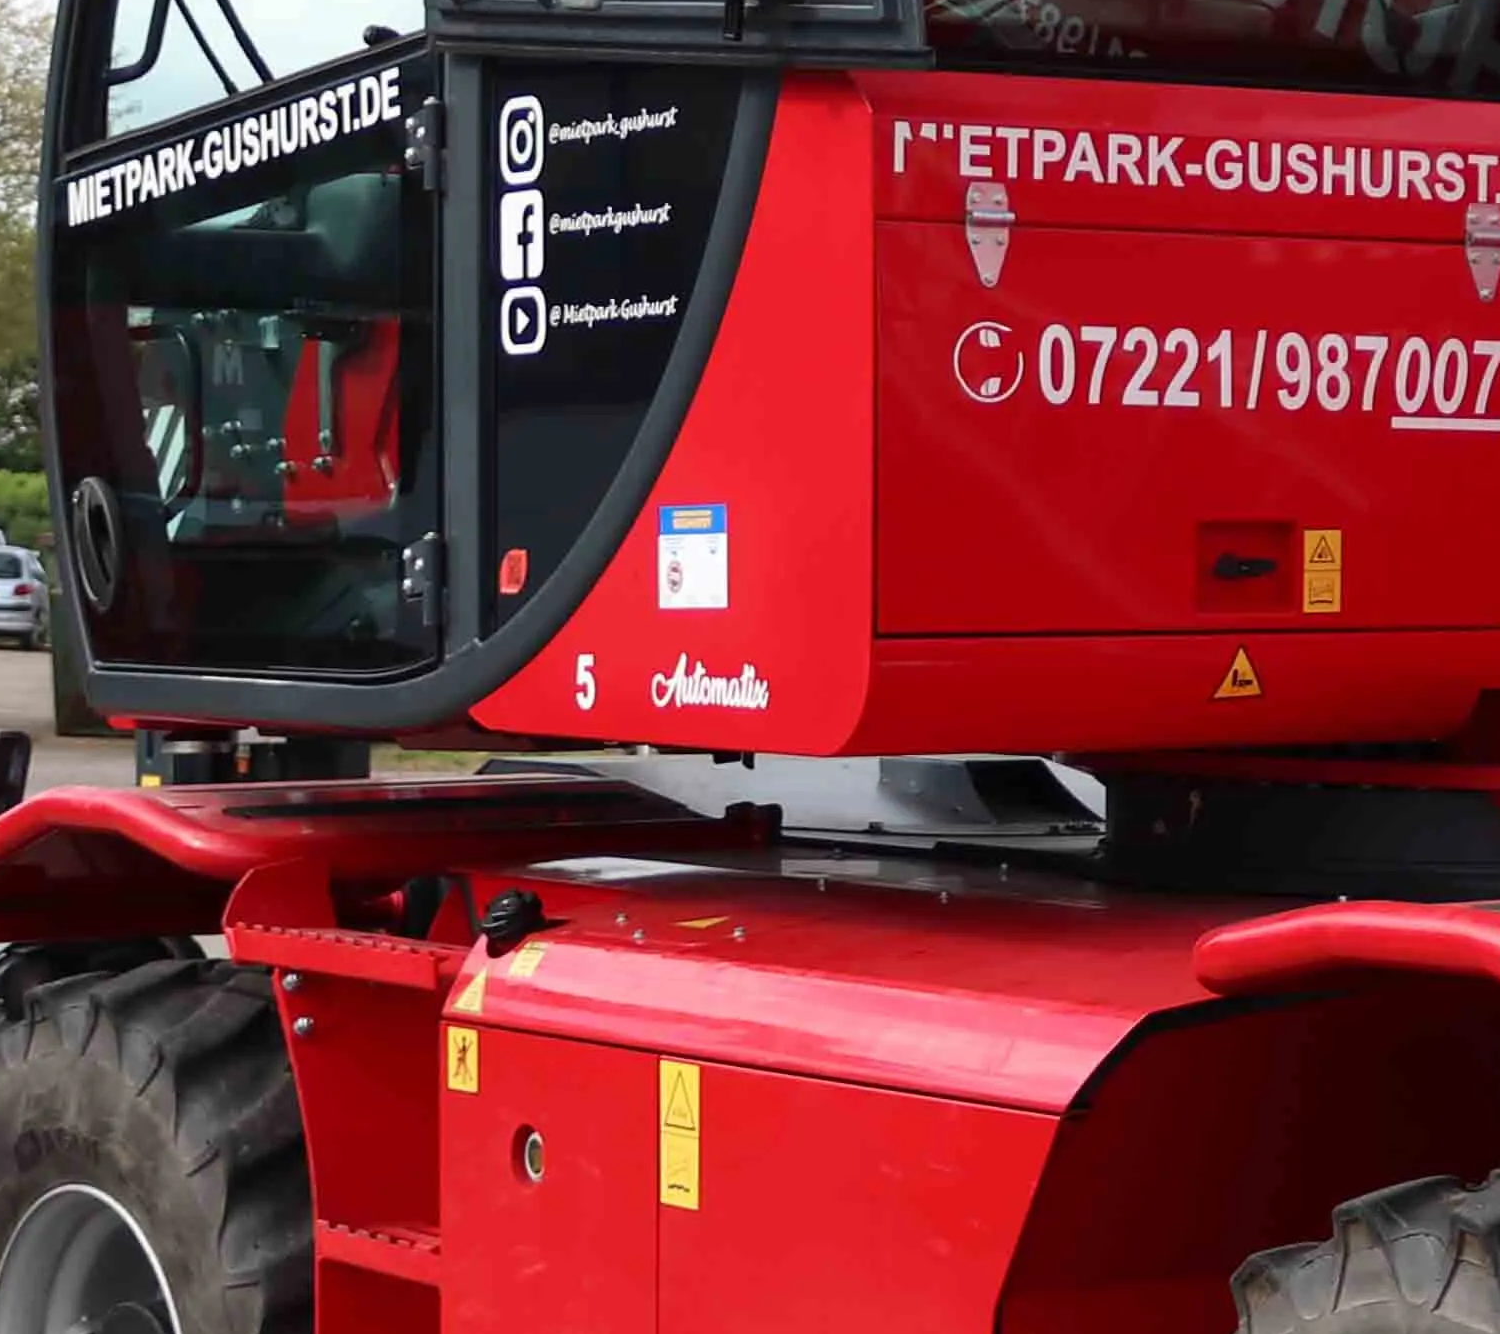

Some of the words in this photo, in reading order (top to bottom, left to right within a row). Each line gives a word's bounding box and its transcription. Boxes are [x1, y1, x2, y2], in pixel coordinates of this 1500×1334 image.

[67, 57, 402, 228] MIETPARK-GUSHURST.DE
[575, 653, 596, 710] 5
[651, 651, 769, 709] Automatix
